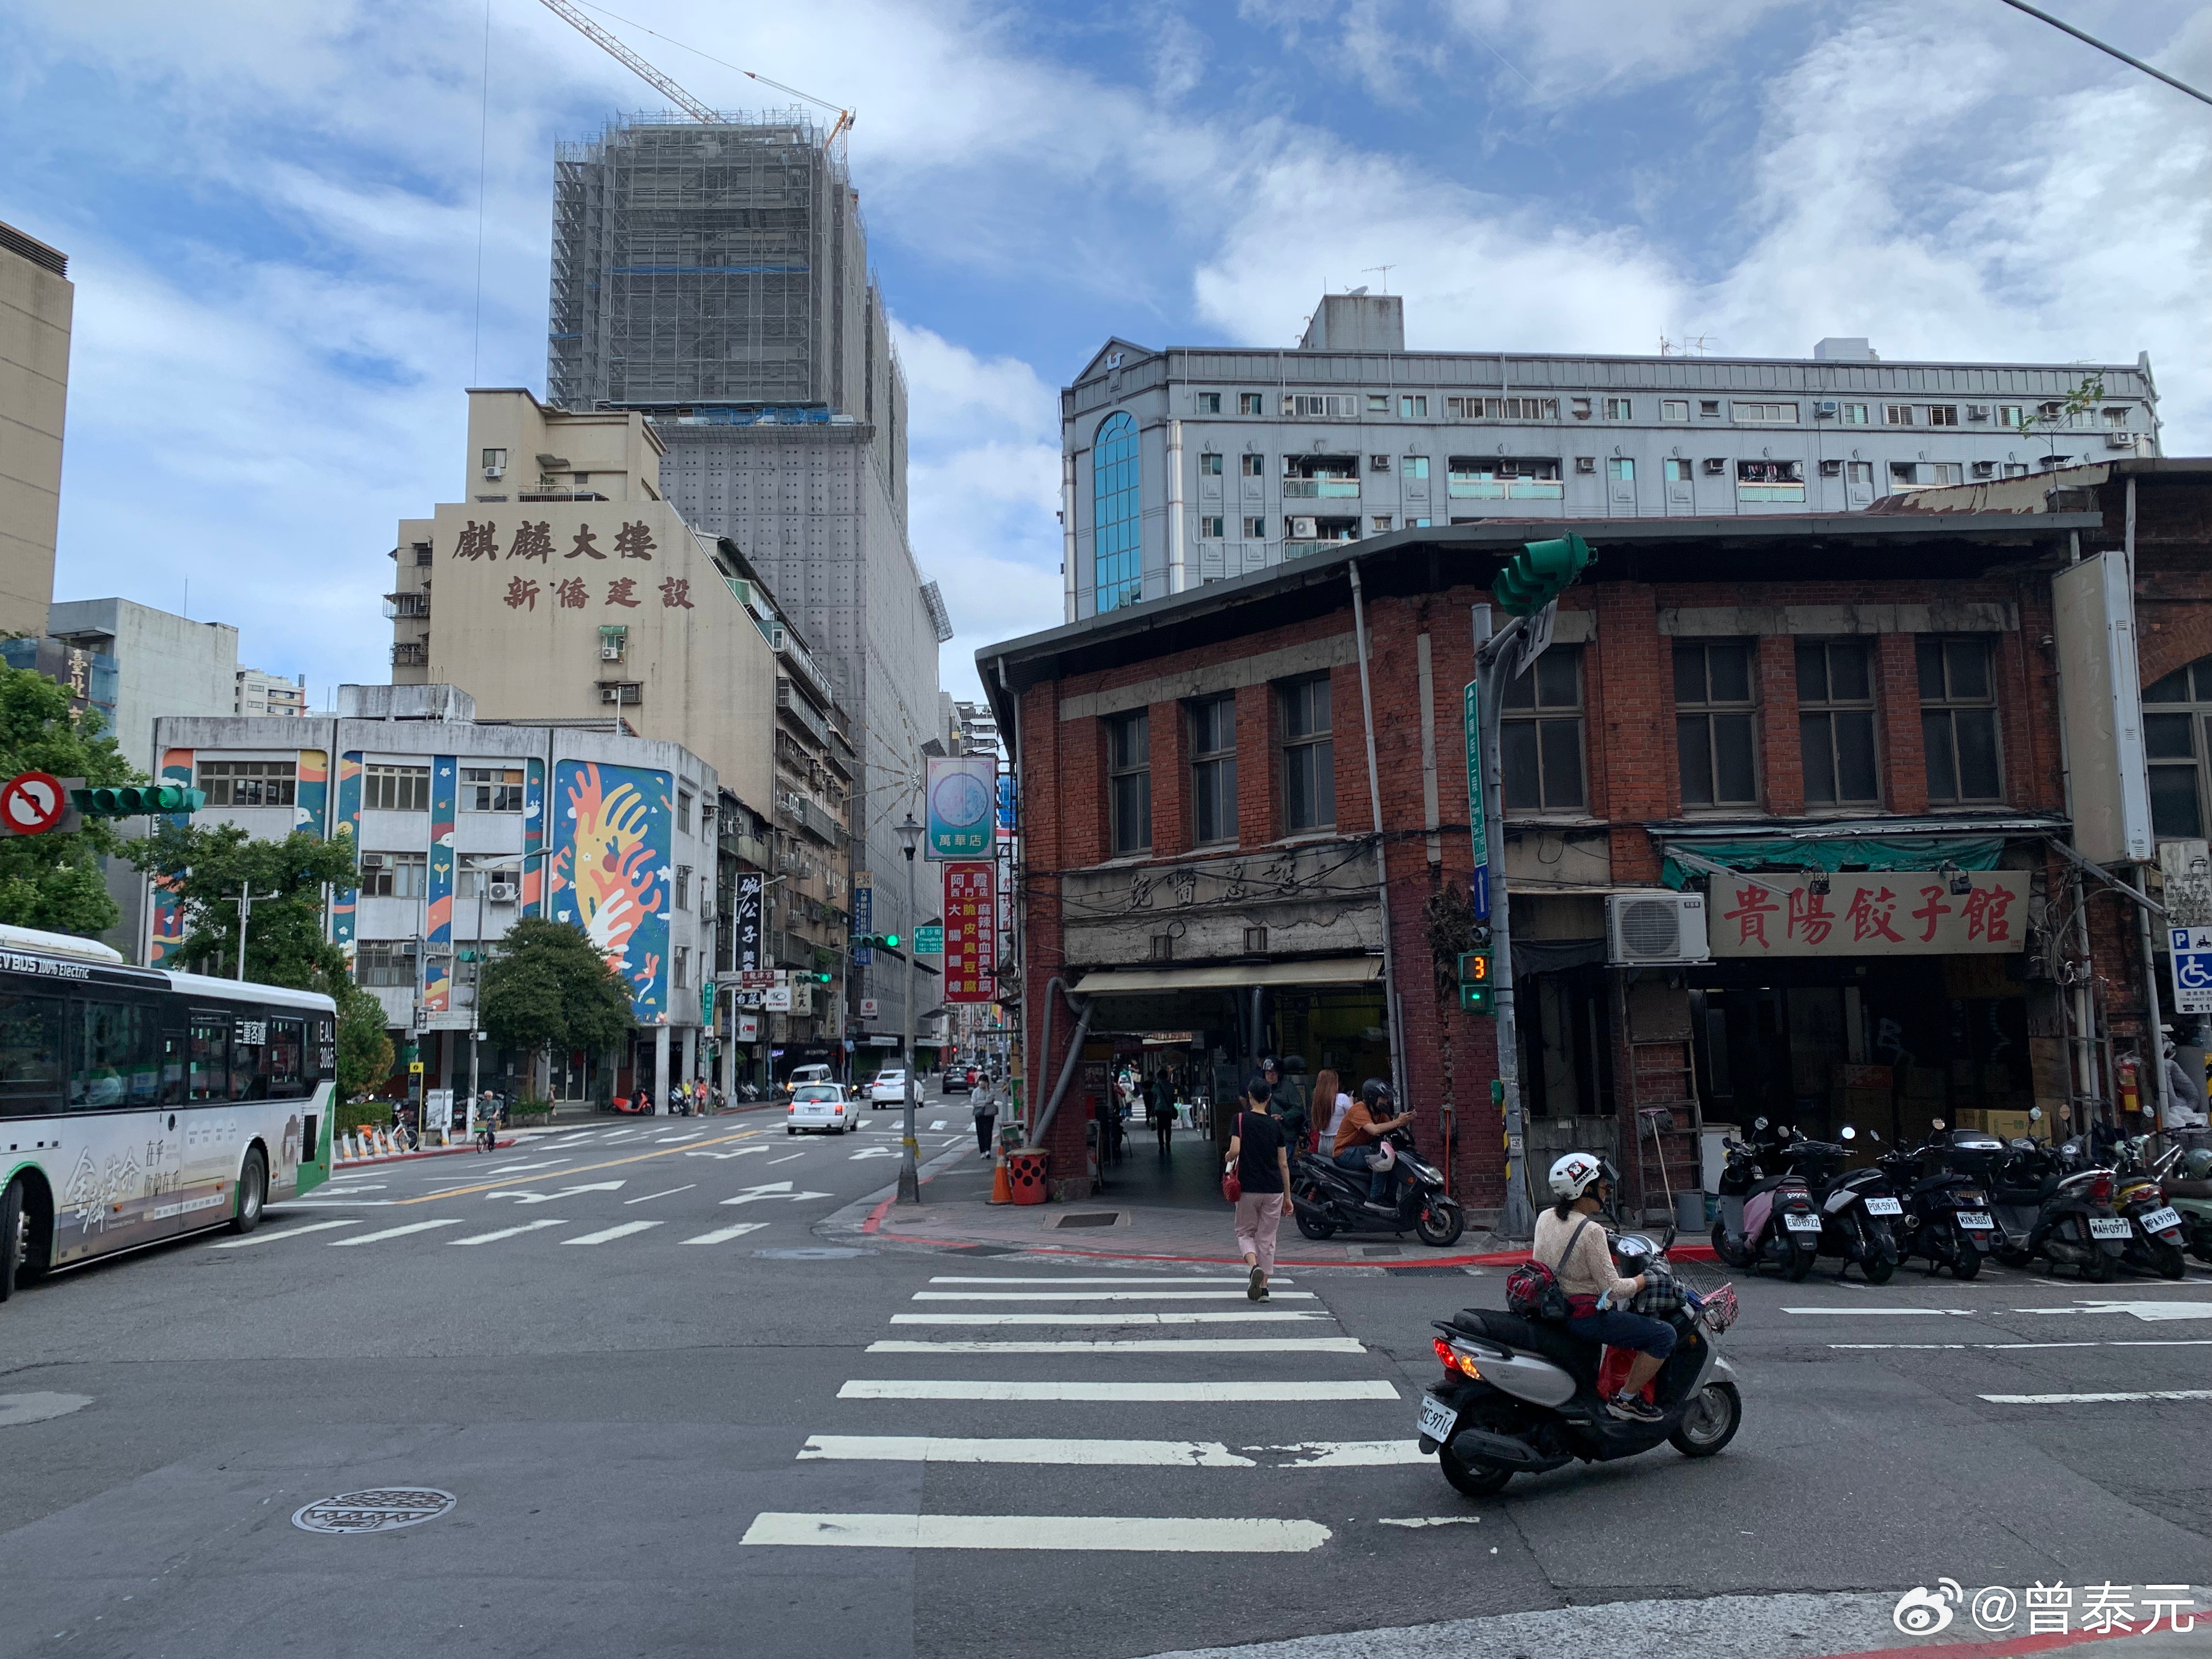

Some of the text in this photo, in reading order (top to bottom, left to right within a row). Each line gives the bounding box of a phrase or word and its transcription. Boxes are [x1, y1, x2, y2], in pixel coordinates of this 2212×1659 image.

[452, 520, 658, 563] 麒麟大樓
[503, 576, 694, 612] 新僑建設
[939, 834, 982, 847] 萬華店
[950, 873, 988, 888] 阿霞
[951, 888, 988, 898] 西門店
[1723, 883, 2016, 949] 貴陽餃子館
[948, 904, 961, 993] 大腸麵線
[963, 904, 977, 993] 脆皮臭豆腐
[978, 904, 991, 992] 麻辣鴨血臭豆腐
[2175, 933, 2186, 946] P
[38, 960, 58, 975] 100%
[59, 963, 90, 979] Electric
[1475, 957, 1485, 978] 3
[234, 1020, 267, 1045] 三重客運
[319, 1021, 334, 1042] EAL
[319, 1047, 334, 1069] 3065
[1573, 1168, 1594, 1188] KUMAMON
[1867, 1202, 1899, 1211] PDK-5917
[1960, 1216, 1990, 1226] MXN-3031
[2092, 1222, 2129, 1234] MAH-0977
